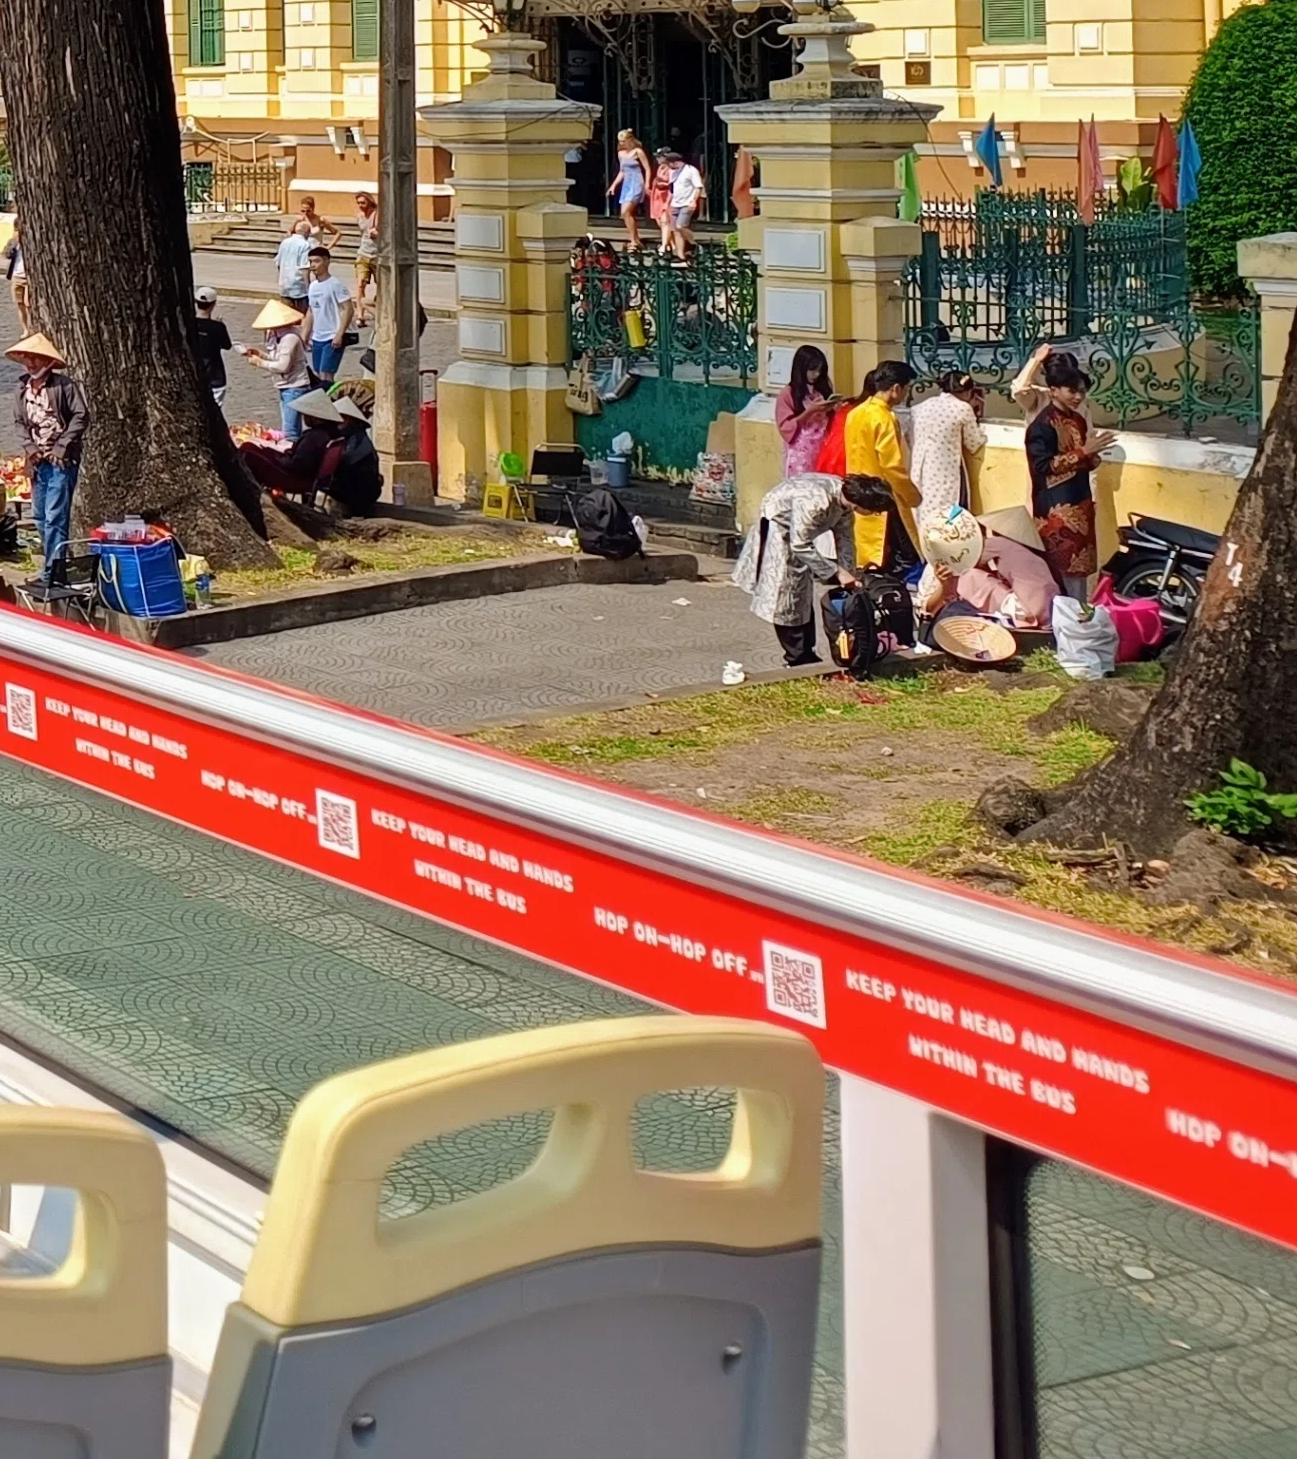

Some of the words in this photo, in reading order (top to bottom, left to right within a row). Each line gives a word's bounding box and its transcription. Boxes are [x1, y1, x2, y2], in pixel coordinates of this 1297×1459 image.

[201, 770, 226, 791] HOP
[227, 779, 279, 809] ON-HOP
[371, 809, 407, 833] KEEP
[408, 822, 445, 848] YOUR
[448, 835, 487, 862] HEAD
[489, 849, 520, 873] AND
[522, 860, 574, 892] HANDS
[414, 859, 462, 890] WITHIN
[464, 877, 493, 901] THE
[496, 888, 527, 914] BUS
[594, 907, 629, 934] HOP
[633, 921, 707, 962] ON-HOP
[845, 969, 896, 1002] KEEP
[901, 988, 954, 1024] YOUR
[960, 1009, 1016, 1045] HEAD
[1021, 1030, 1067, 1063] AND
[1072, 1048, 1150, 1094] HANDS
[908, 1035, 978, 1077] WITHIN
[982, 1062, 1025, 1095] THE
[1030, 1080, 1076, 1114] BUS
[1167, 1110, 1222, 1147] HOP
